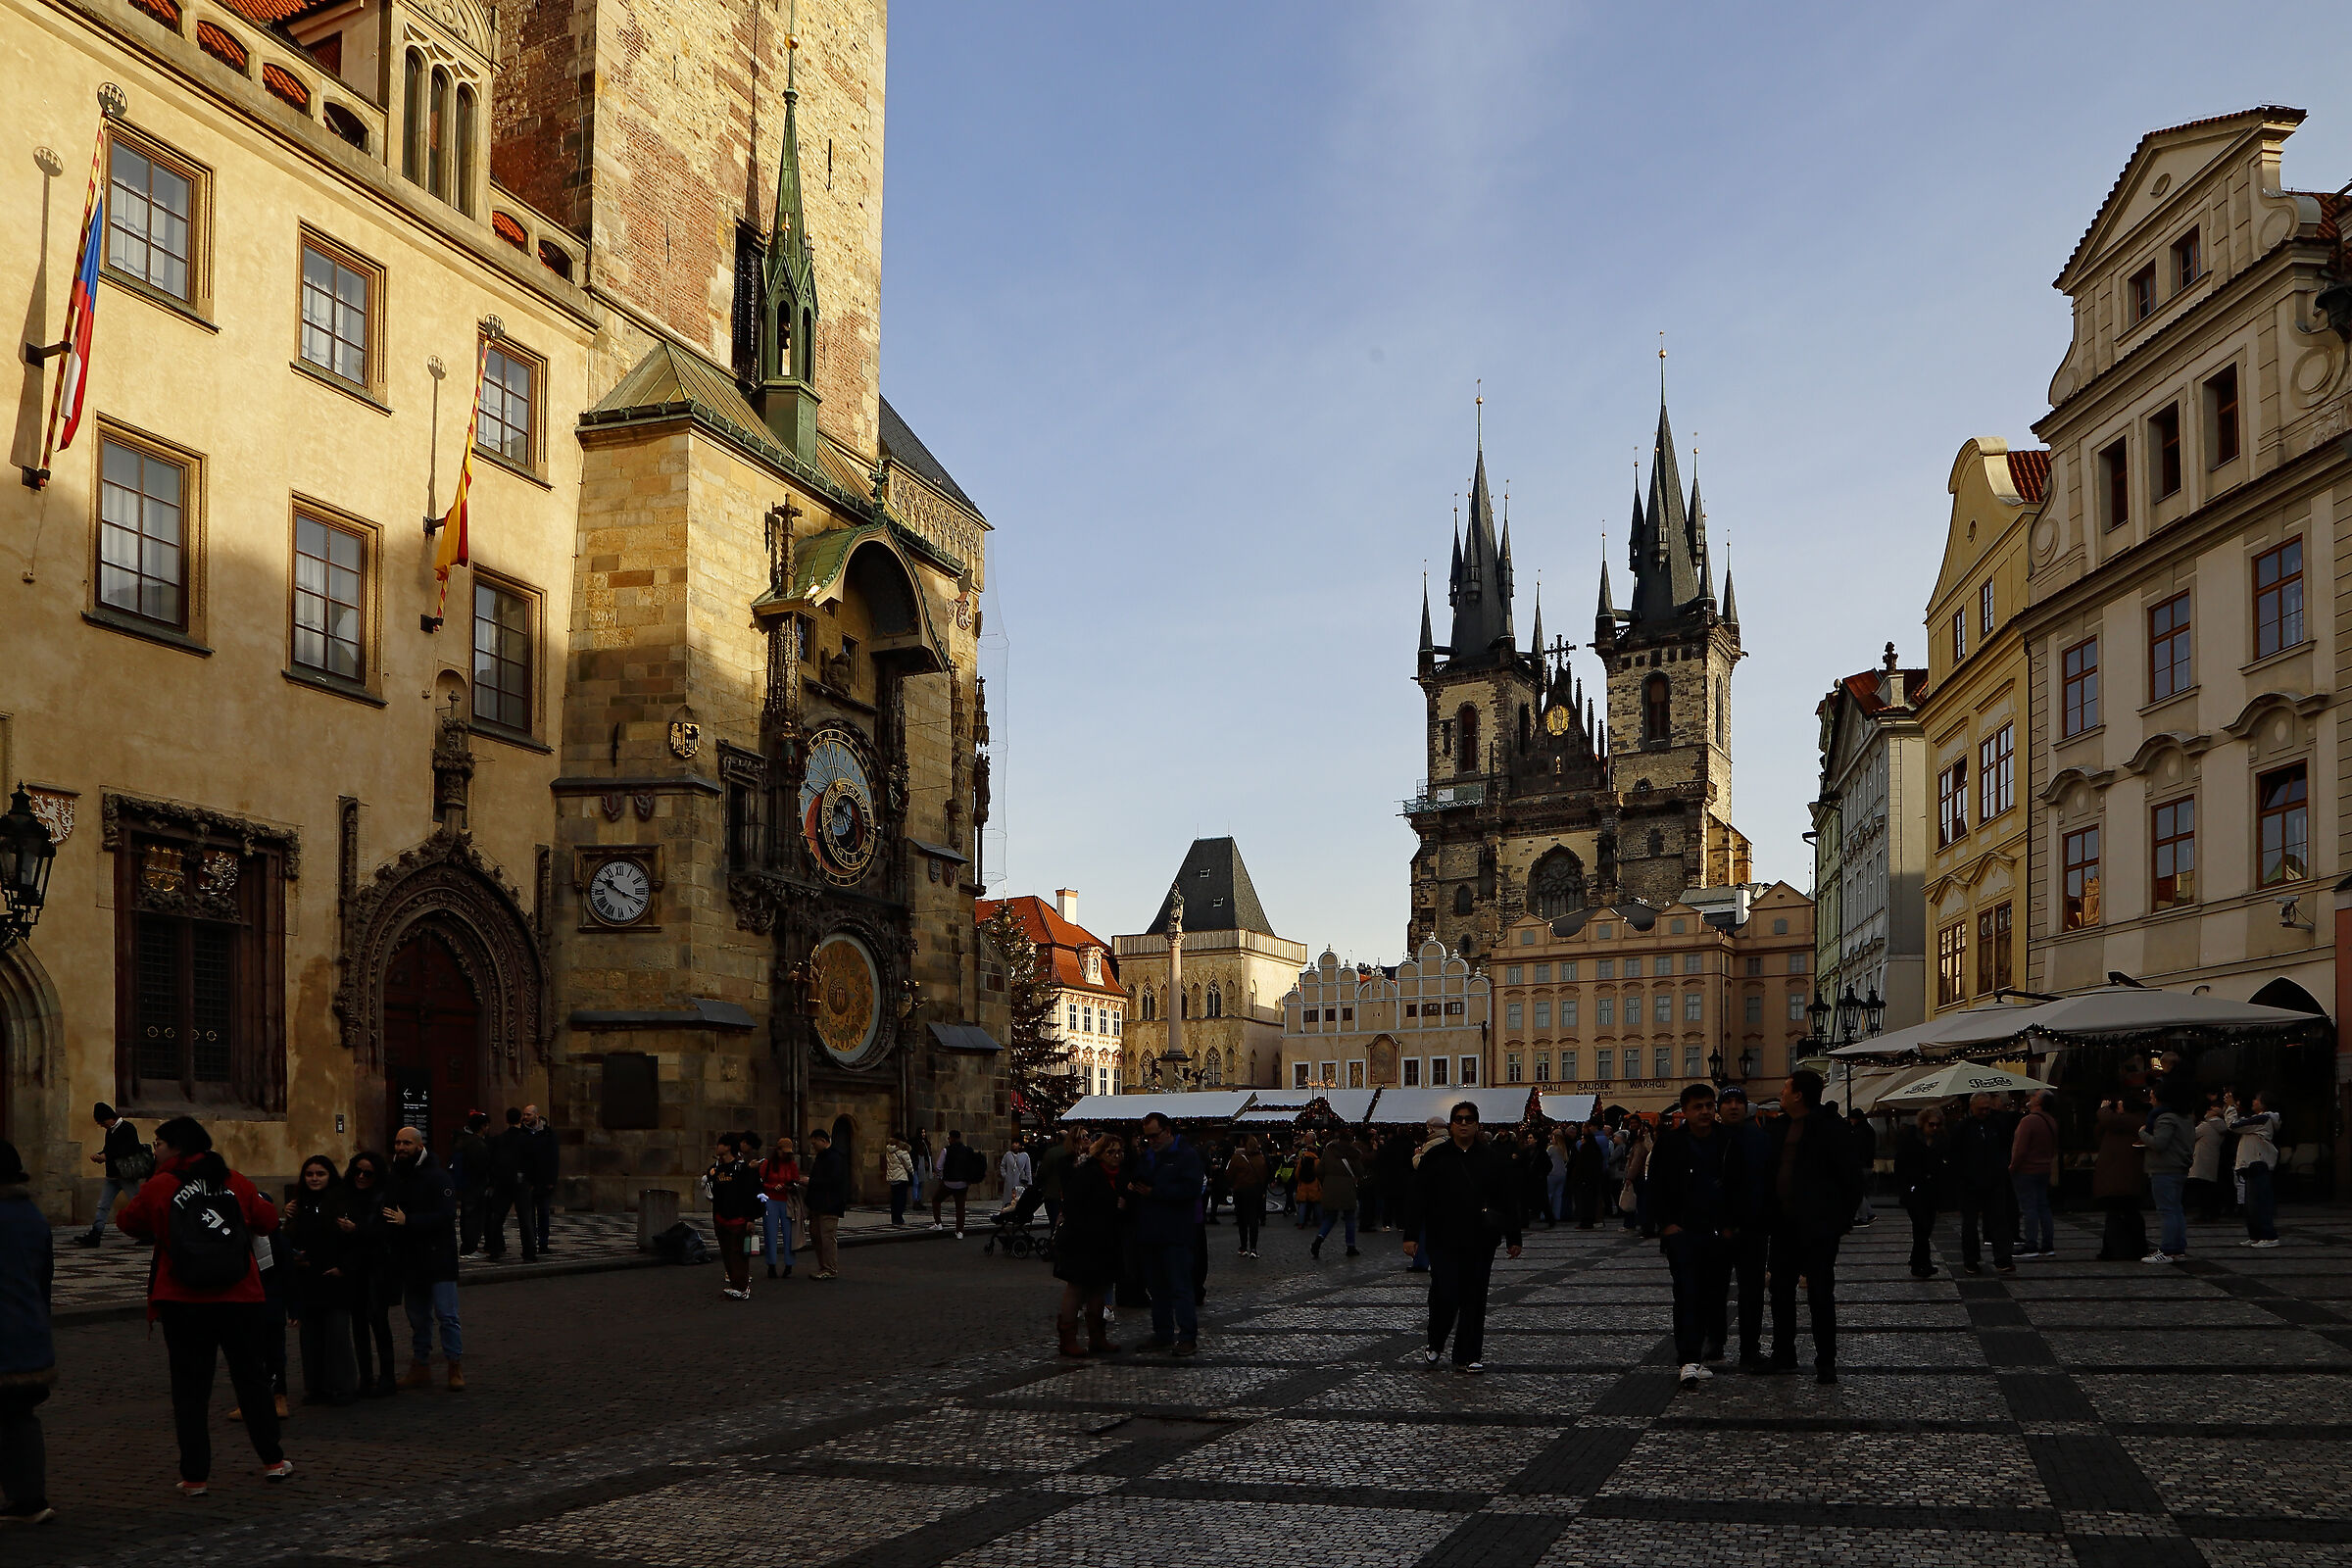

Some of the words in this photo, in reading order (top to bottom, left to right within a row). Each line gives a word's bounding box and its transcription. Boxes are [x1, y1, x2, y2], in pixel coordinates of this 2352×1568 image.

[614, 865, 624, 876] XII
[635, 887, 646, 896] III
[1577, 1082, 1611, 1091] SAUDEK
